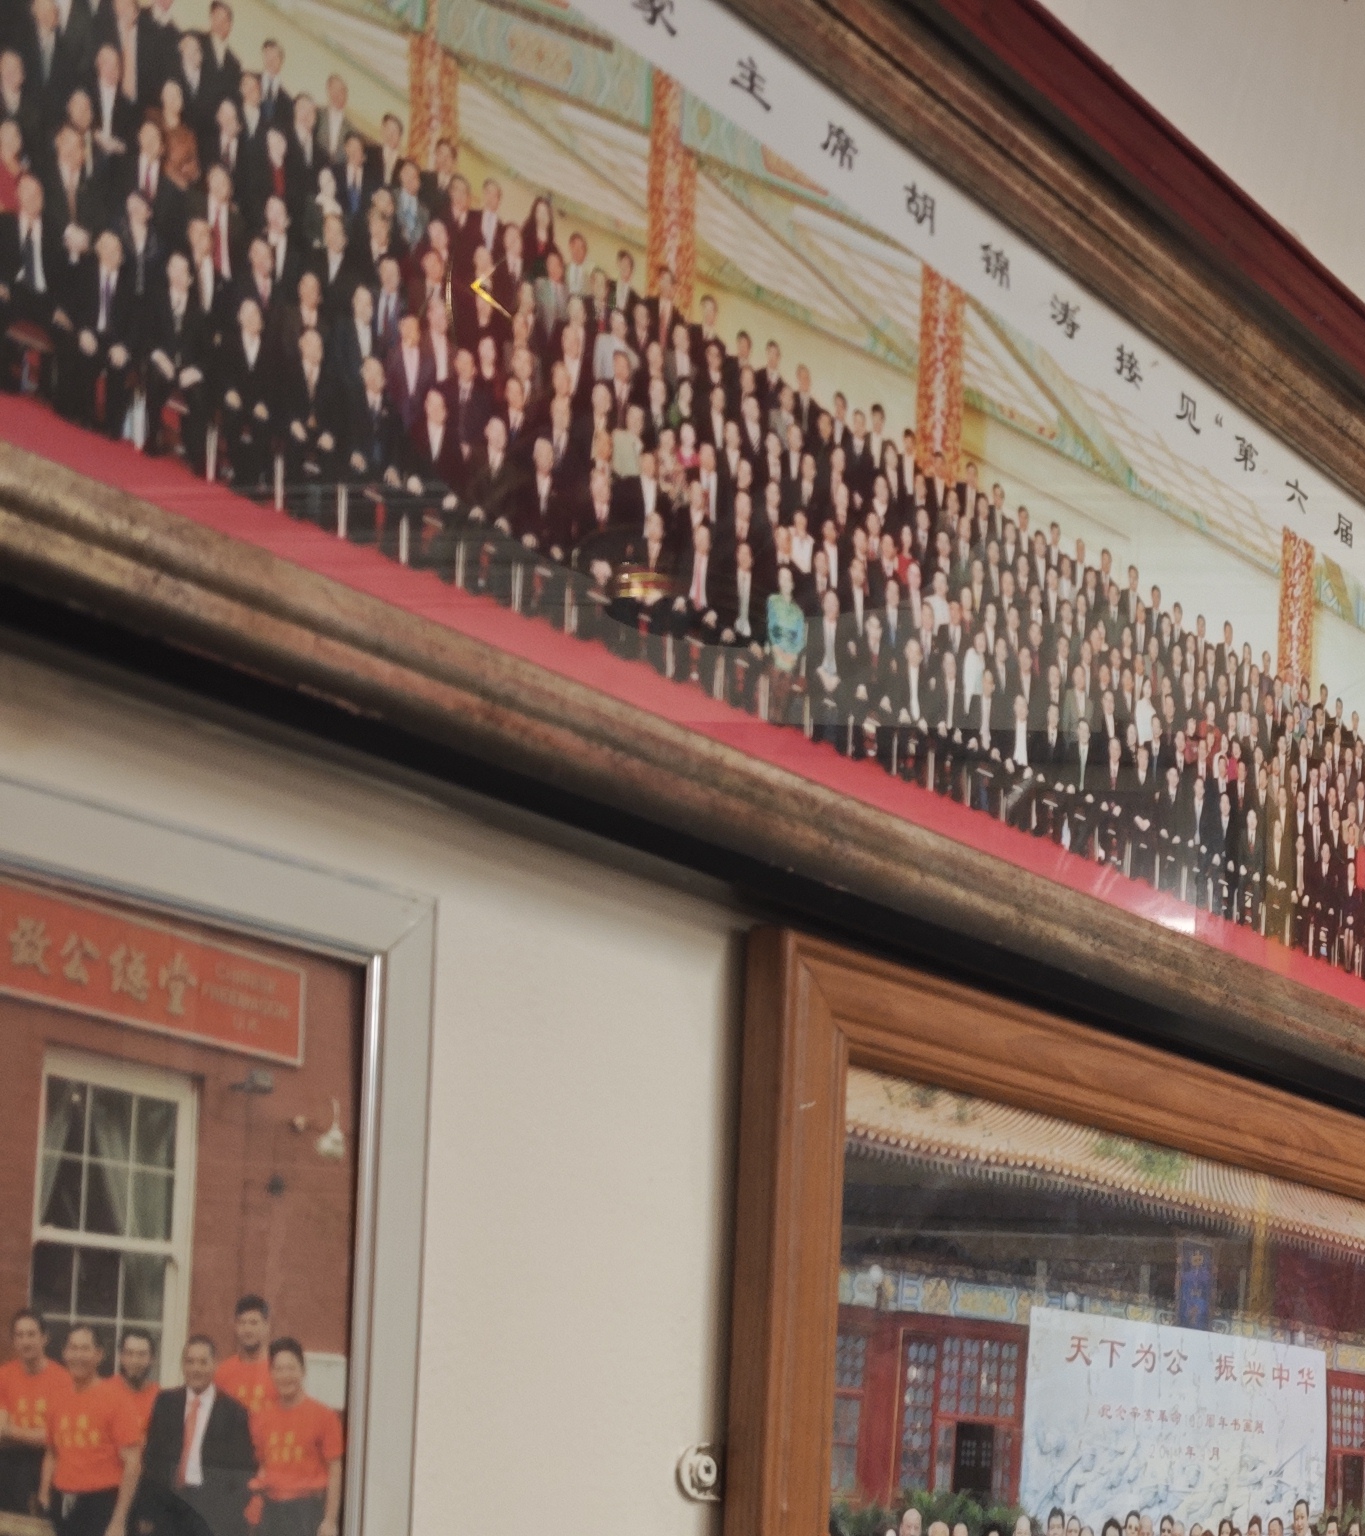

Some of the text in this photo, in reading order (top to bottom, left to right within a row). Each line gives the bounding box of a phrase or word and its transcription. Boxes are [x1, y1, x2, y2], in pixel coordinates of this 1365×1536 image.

[1064, 1334, 1318, 1395] 天下为公 振兴中华
